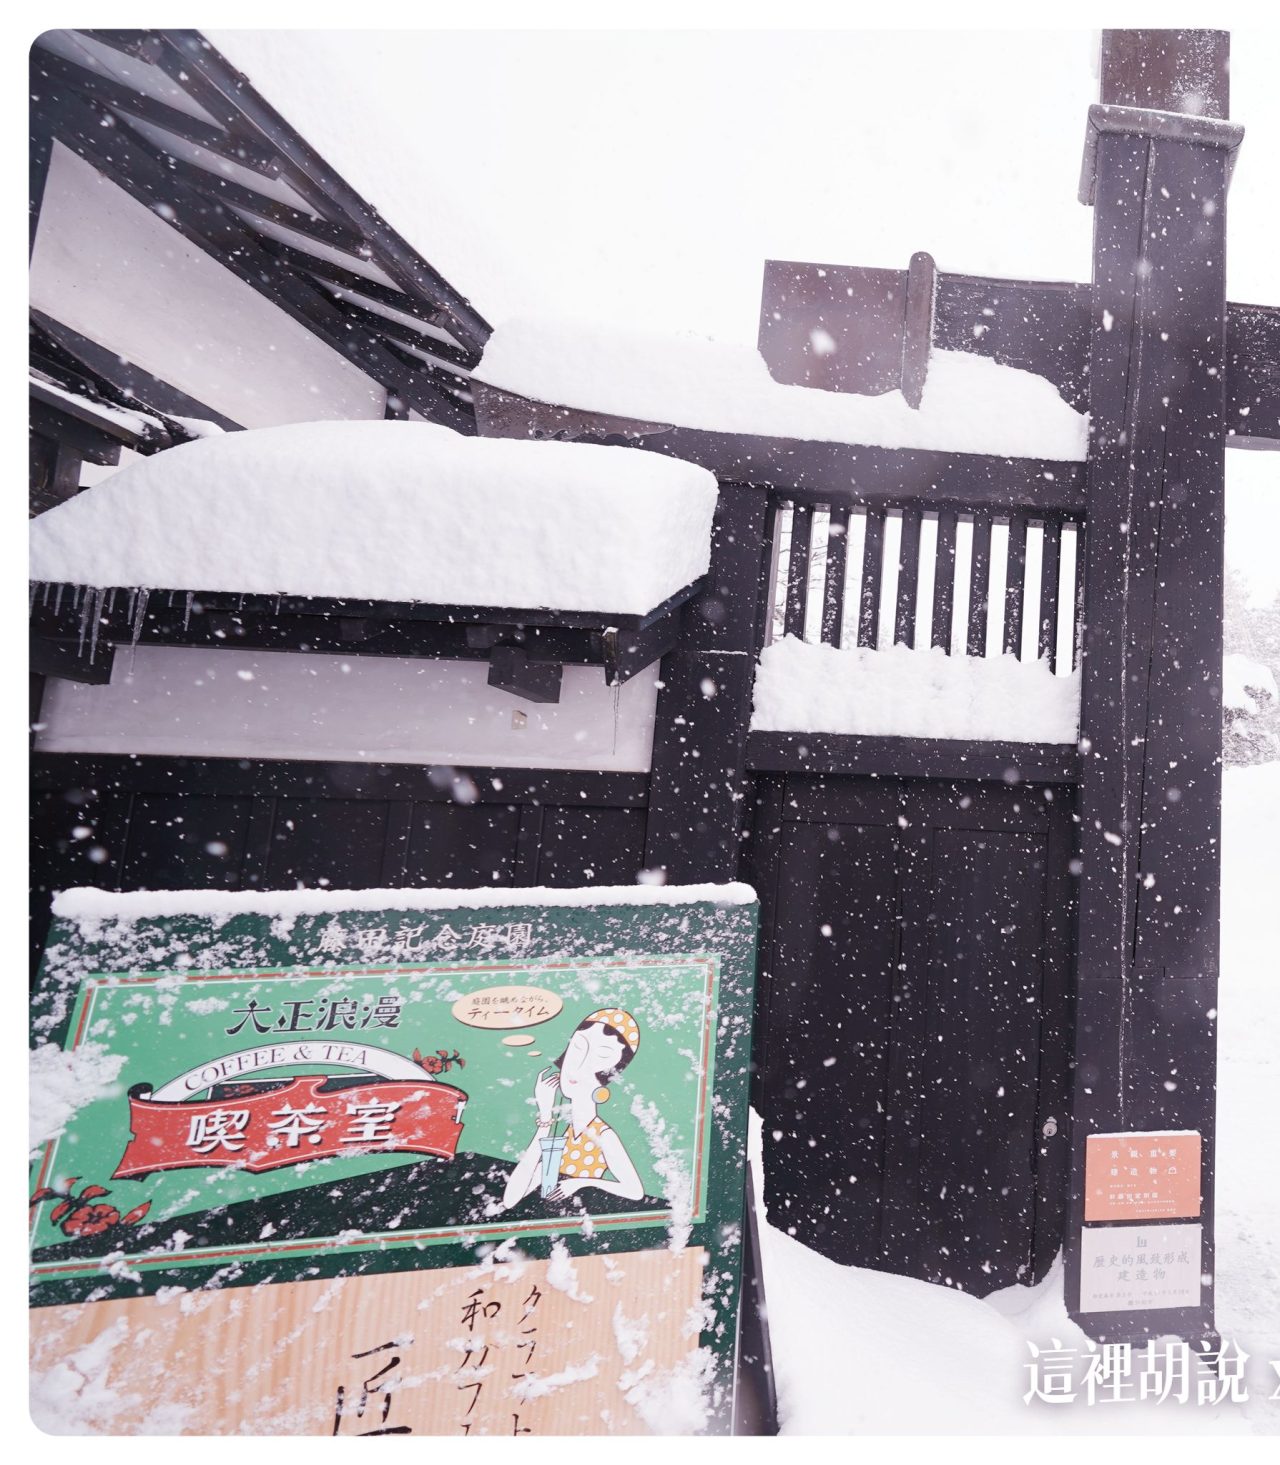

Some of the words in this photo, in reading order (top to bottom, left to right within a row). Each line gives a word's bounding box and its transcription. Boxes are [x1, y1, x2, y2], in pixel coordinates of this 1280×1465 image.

[226, 996, 402, 1035] 大正浪漫
[467, 1006, 550, 1020] ティータイム
[184, 1048, 285, 1091] COFFEE
[293, 1045, 312, 1060] &
[322, 1045, 367, 1066] TEA
[185, 1097, 401, 1154] 喫茶室
